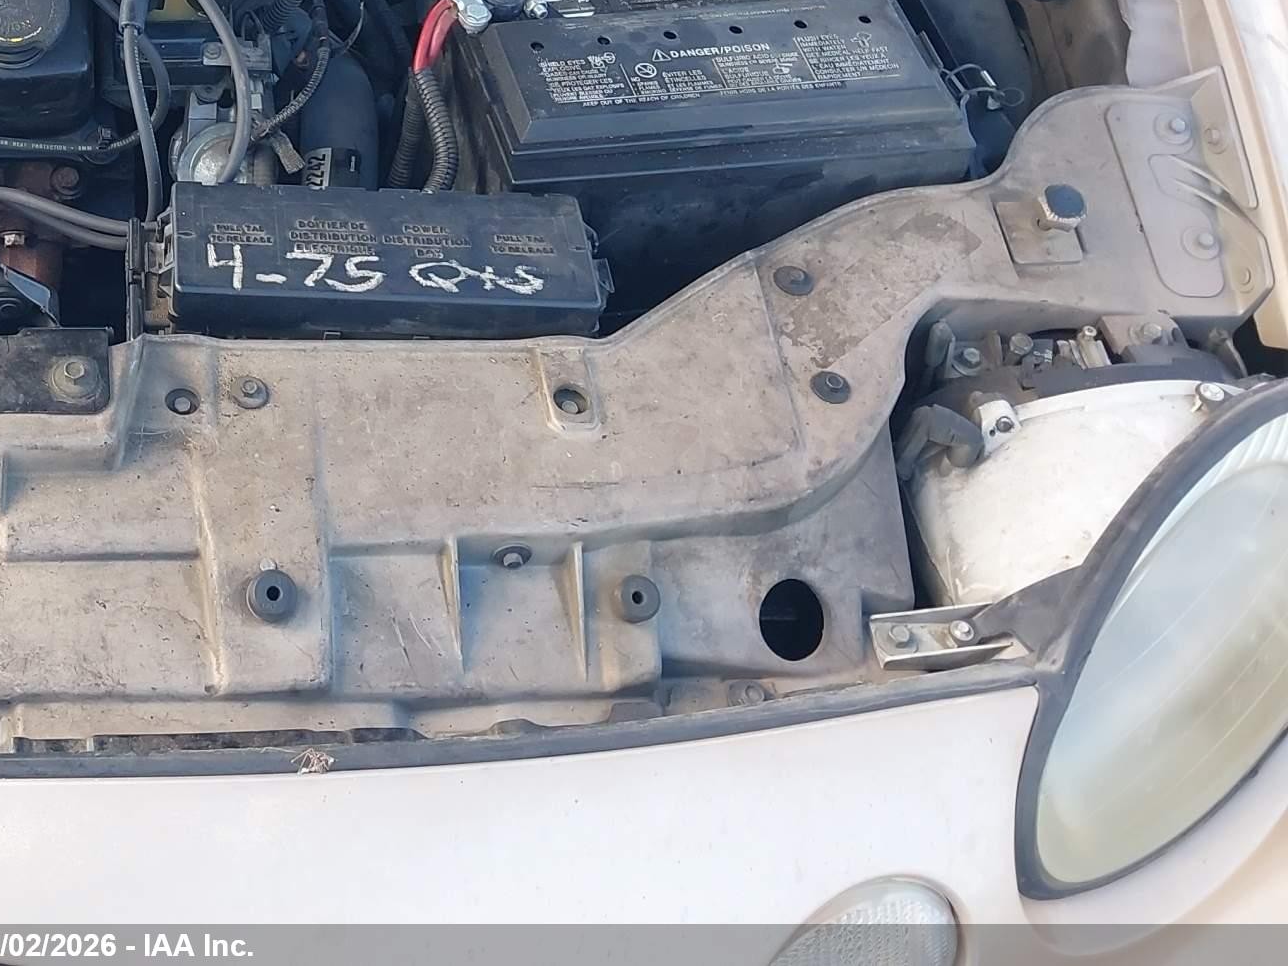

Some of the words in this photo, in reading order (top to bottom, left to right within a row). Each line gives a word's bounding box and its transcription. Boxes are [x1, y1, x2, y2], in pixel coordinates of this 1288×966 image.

[670, 43, 770, 58] DANGER/POISON
[32, 143, 67, 151] PROTECTION
[403, 224, 450, 234] POWER
[290, 231, 378, 244] DISTRIBUTION
[383, 235, 472, 248] DISTRIBUTION
[495, 235, 522, 244] PULL
